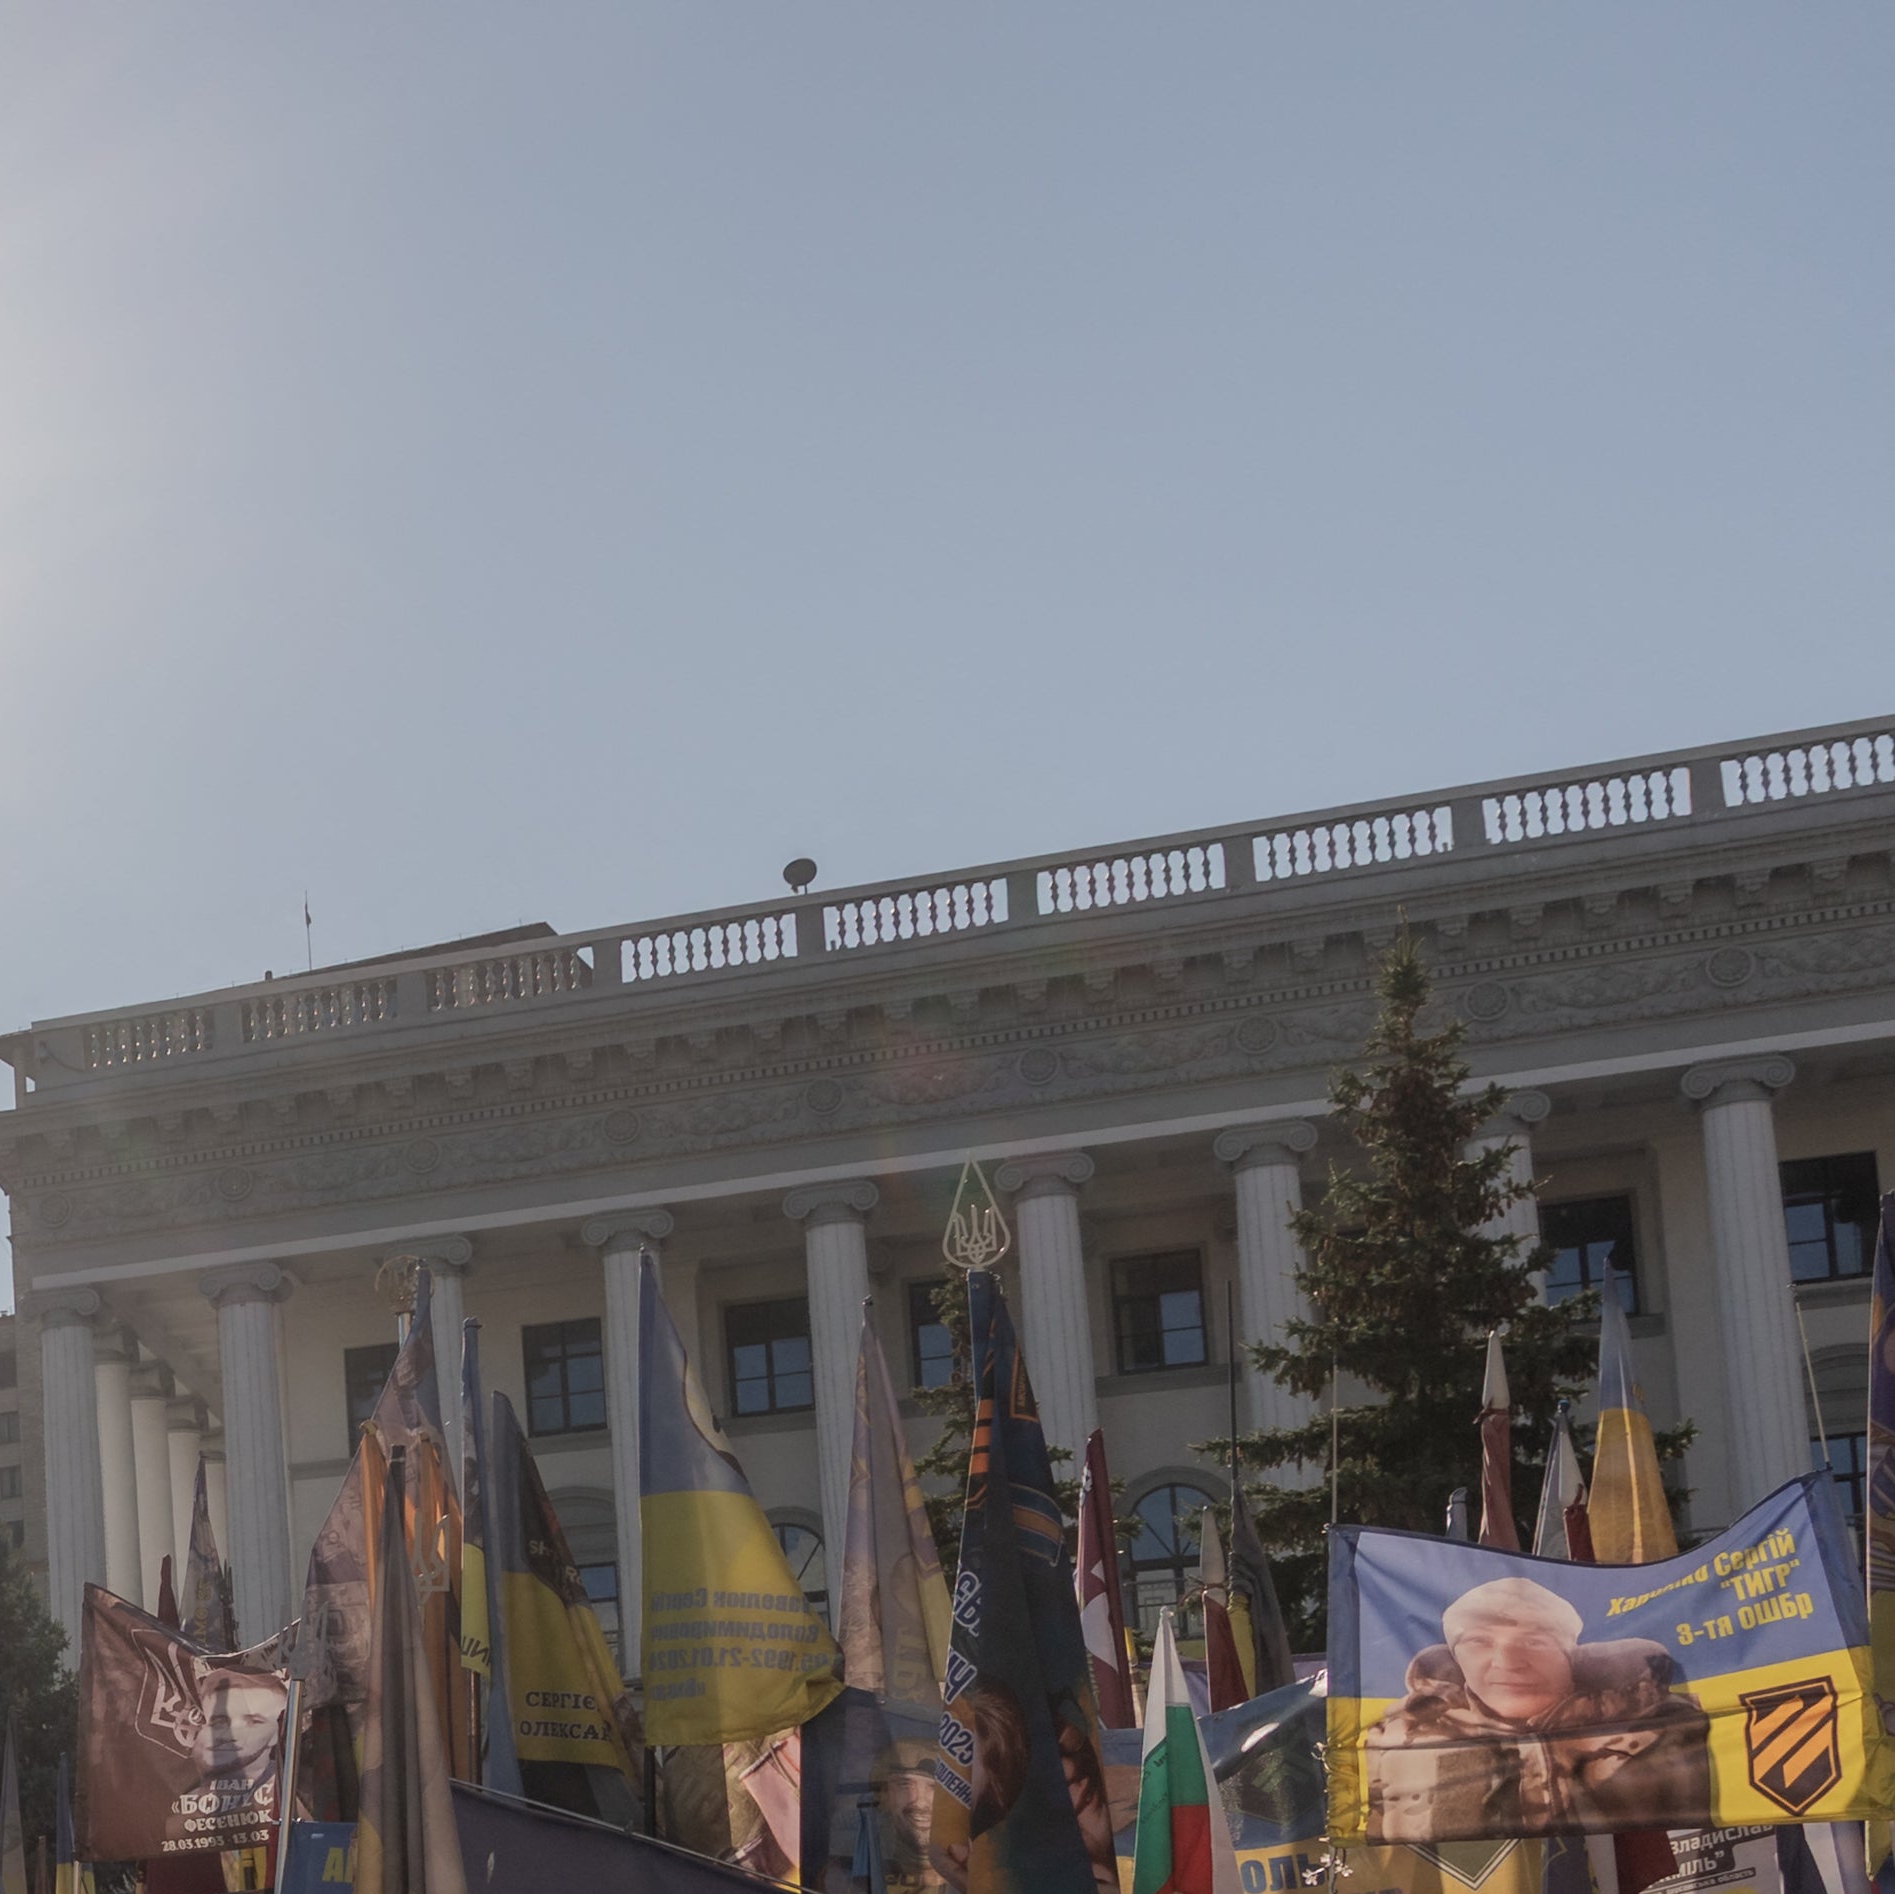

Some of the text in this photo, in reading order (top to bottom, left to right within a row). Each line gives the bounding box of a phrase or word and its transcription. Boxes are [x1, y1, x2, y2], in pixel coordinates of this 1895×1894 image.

[1714, 1528, 1796, 1577] Сергій
[525, 1692, 599, 1711] СЕРГІЄ
[183, 1809, 273, 1833] ФЕСЕНЮК
